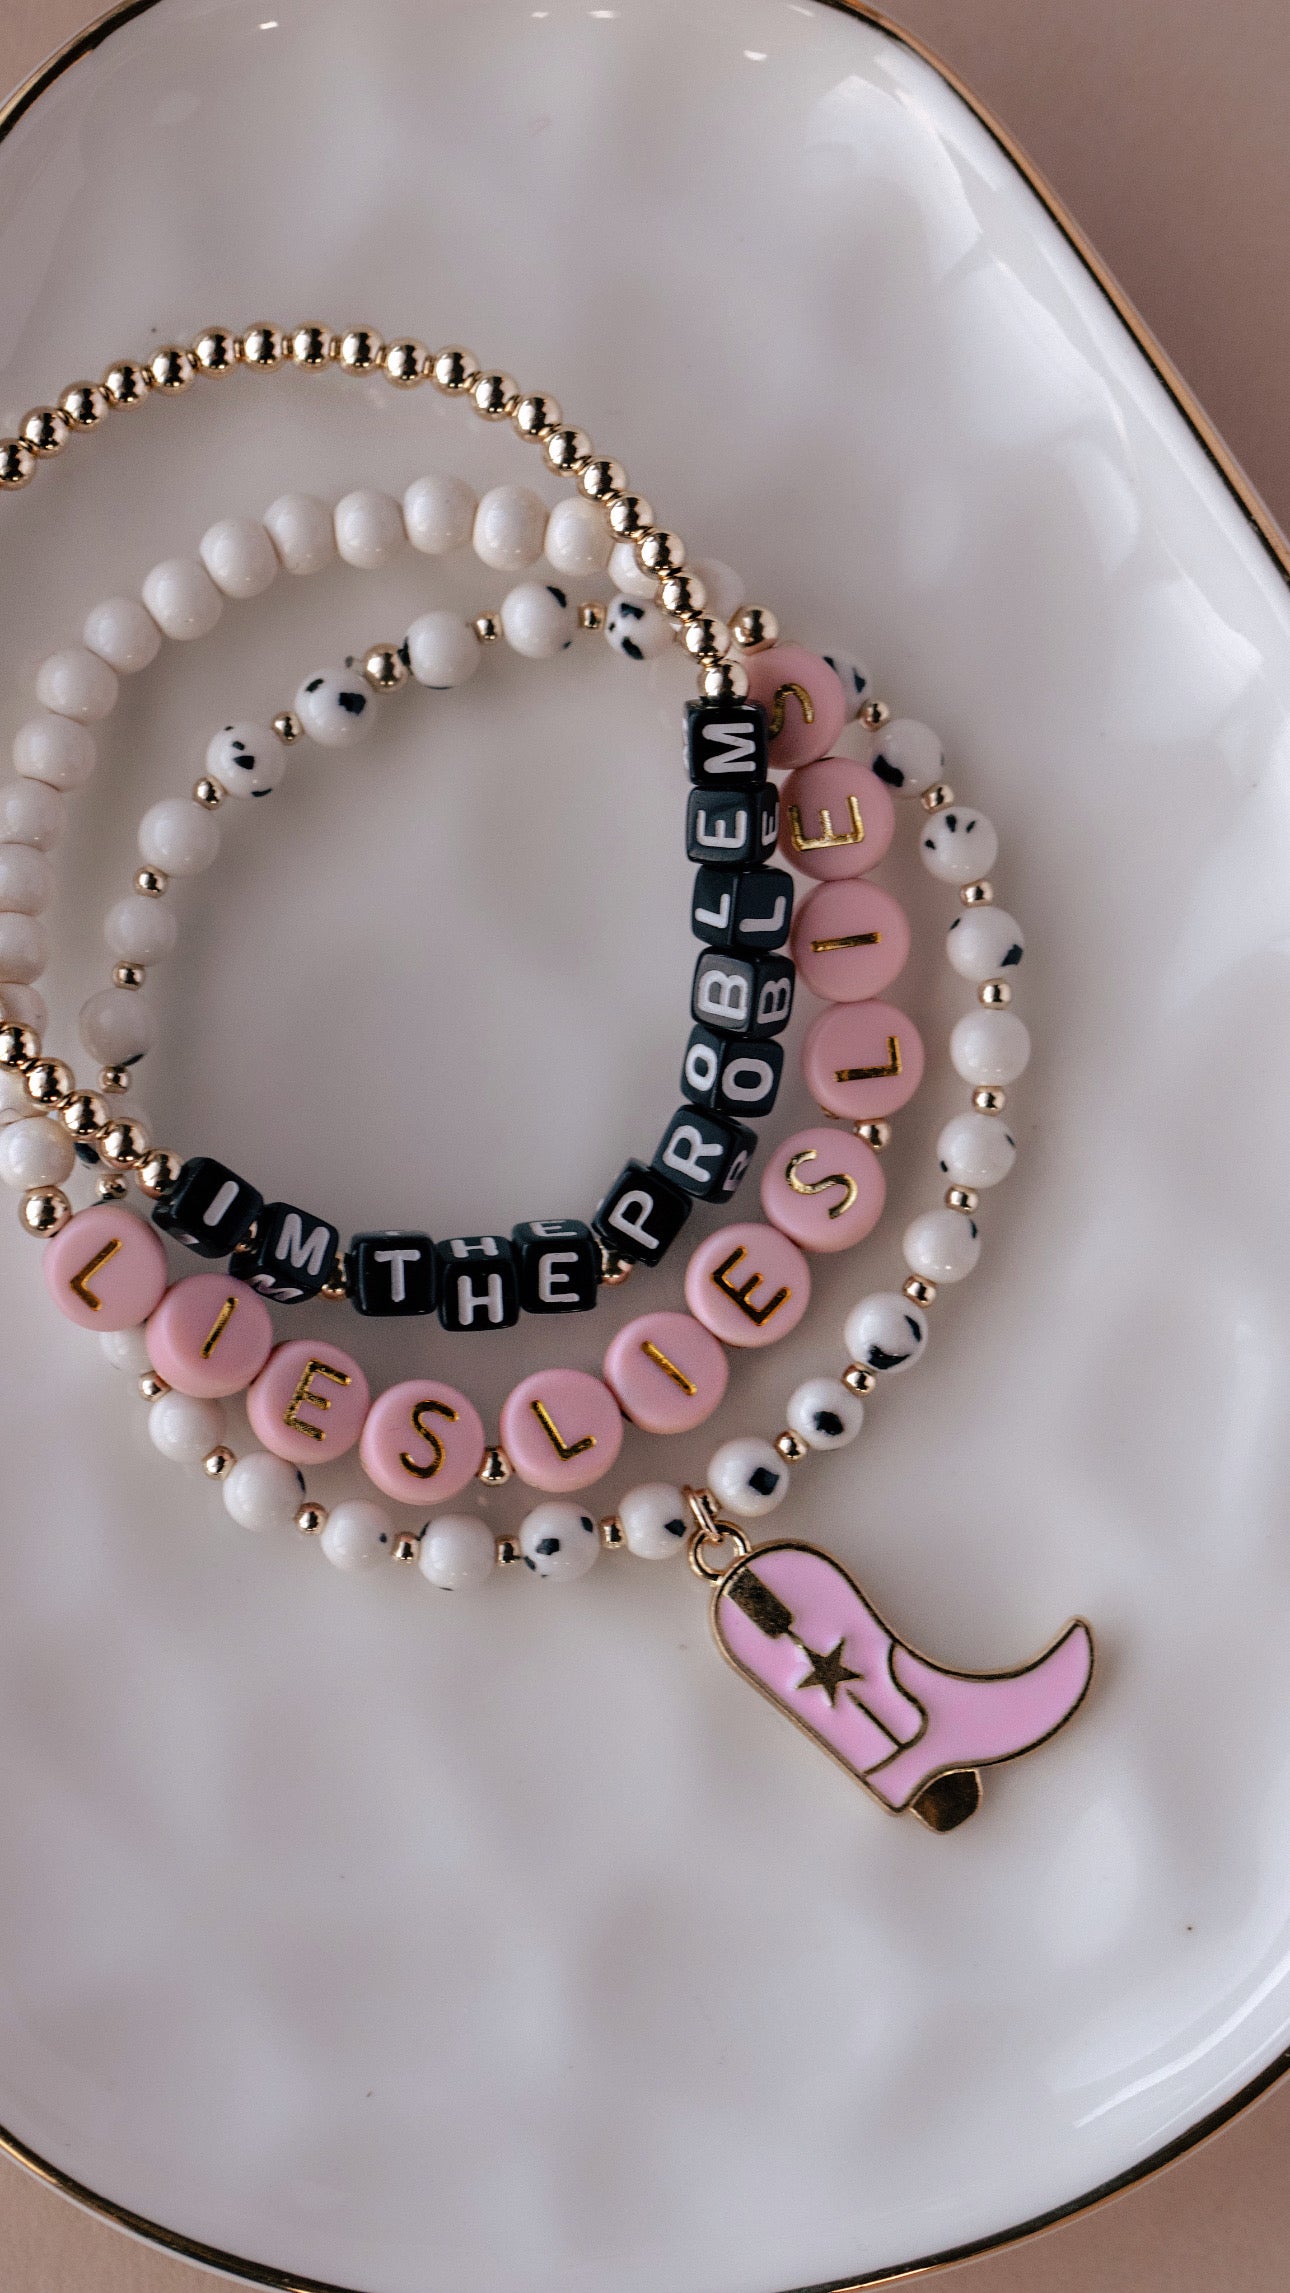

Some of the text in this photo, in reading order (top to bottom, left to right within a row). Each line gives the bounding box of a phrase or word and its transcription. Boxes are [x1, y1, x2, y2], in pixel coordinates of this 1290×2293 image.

[374, 1249, 580, 1326] THE
[608, 721, 782, 1250] PROBLEM
[70, 1238, 458, 1478] LIES
[530, 1149, 859, 1461] LIES
